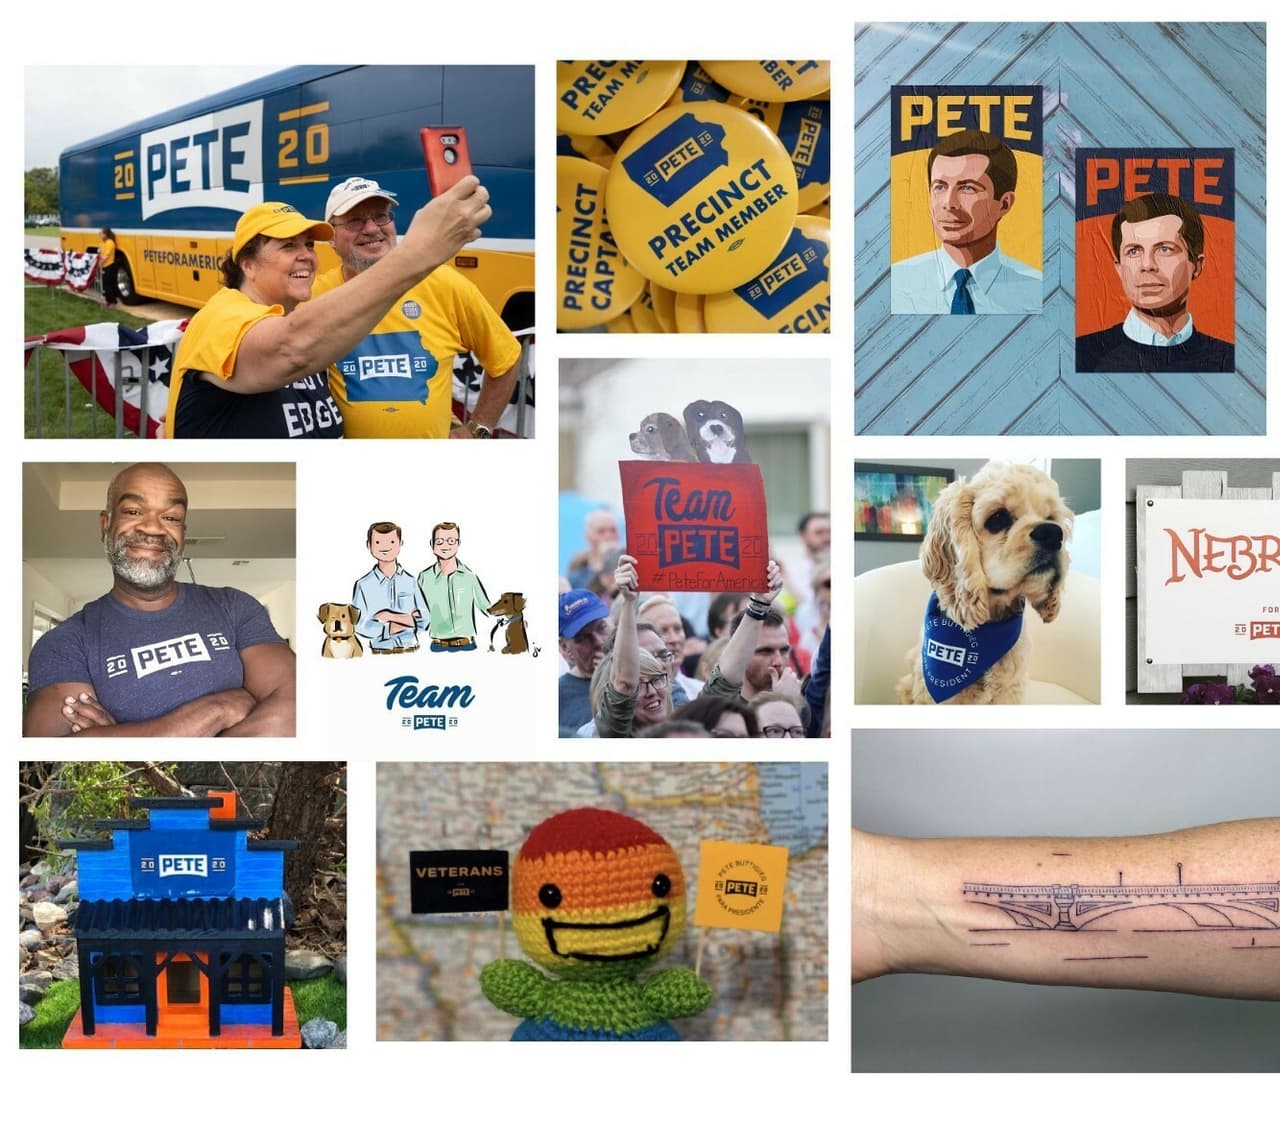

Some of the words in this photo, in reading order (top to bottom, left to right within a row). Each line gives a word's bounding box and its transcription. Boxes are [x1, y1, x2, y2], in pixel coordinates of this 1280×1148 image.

[760, 60, 793, 91] BER
[582, 78, 625, 120] TEAM
[900, 95, 1034, 142] PETE
[114, 162, 135, 189] 20
[147, 120, 252, 201] PETE
[278, 123, 330, 169] 20
[645, 172, 659, 186] 20
[658, 142, 699, 177] PETE
[699, 134, 712, 145] 20
[796, 122, 818, 163] PETE
[1085, 158, 1225, 206] PETE
[647, 158, 773, 260] PRECINCT
[563, 183, 598, 311] PRECINCT
[665, 237, 716, 277] TEAM
[715, 183, 789, 243] MEMBER
[590, 208, 618, 310] CAPTA
[763, 257, 802, 290] PETE
[343, 364, 356, 373] 20
[362, 358, 408, 375] PETE
[413, 359, 427, 370] 20
[282, 396, 343, 438] EDGE
[643, 476, 736, 522] Team
[665, 528, 738, 562] PETE
[1262, 606, 1280, 614] FOR
[106, 659, 127, 673] 20
[137, 637, 203, 670] PETE
[209, 636, 229, 647] 20
[928, 641, 964, 664] PETE
[383, 675, 476, 711] Team
[415, 717, 444, 728] PETE
[140, 860, 156, 870] 20
[162, 857, 205, 873] PETE
[211, 860, 226, 869] 20
[415, 865, 504, 878] VETERANS
[727, 881, 757, 895] PETE
